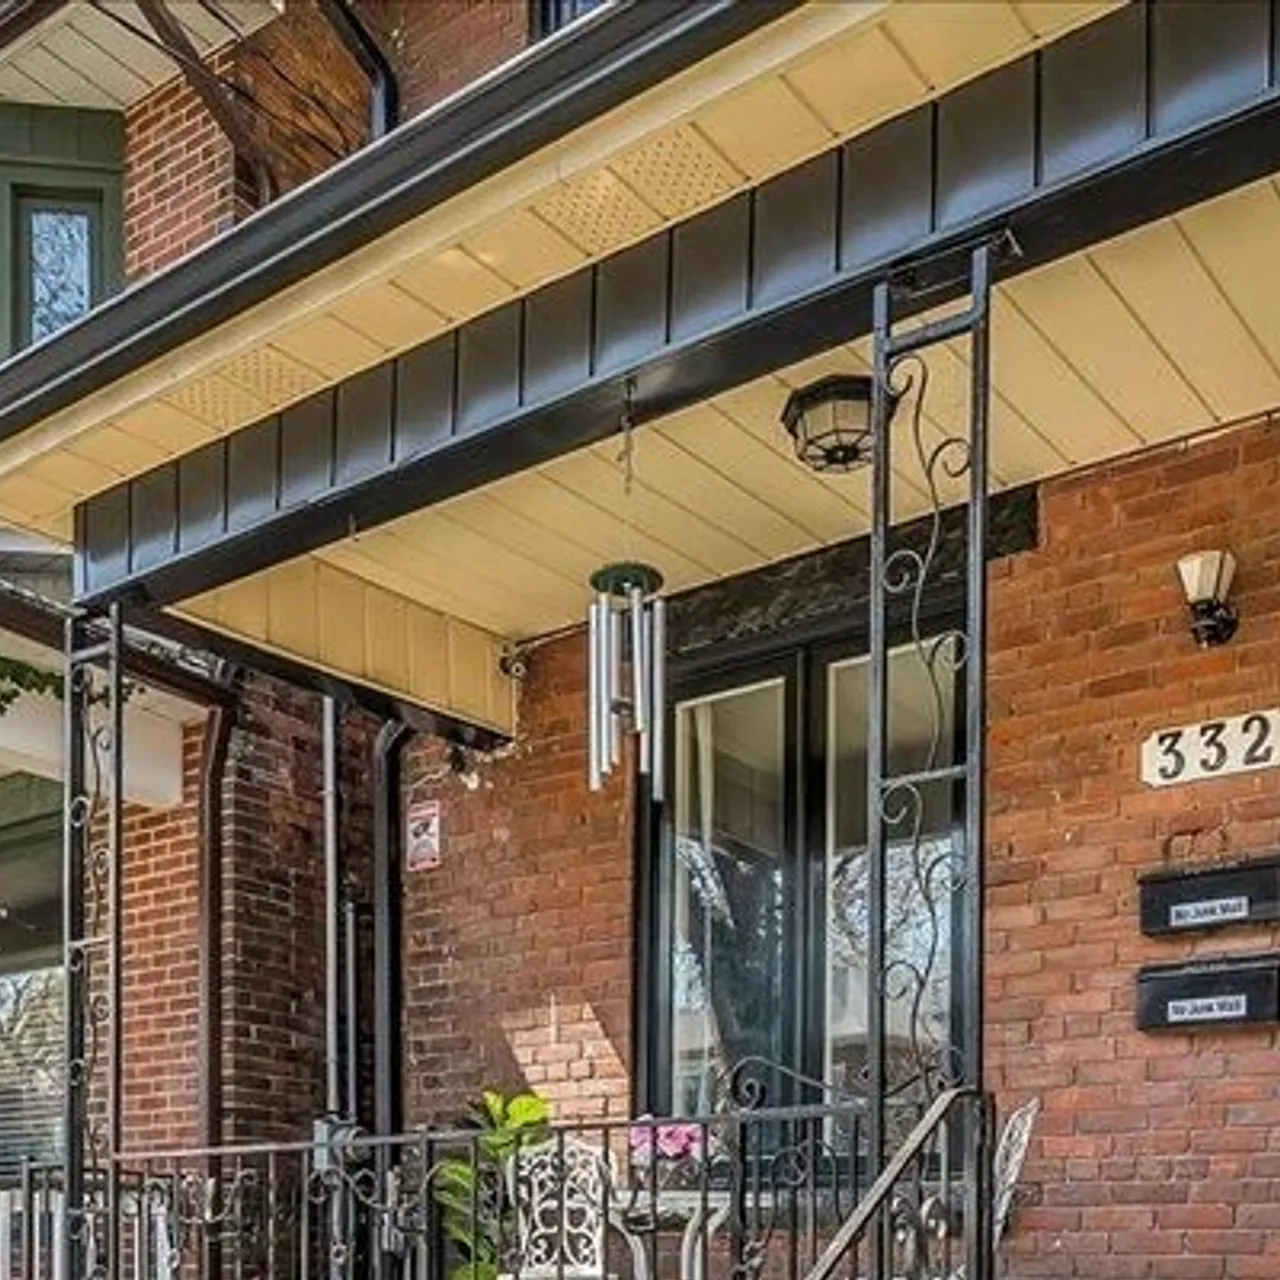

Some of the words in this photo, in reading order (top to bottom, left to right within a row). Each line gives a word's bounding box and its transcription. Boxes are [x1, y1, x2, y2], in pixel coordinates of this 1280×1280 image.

[1157, 713, 1273, 781] 332
[1174, 907, 1191, 920] No
[1191, 903, 1218, 919] Junk
[1219, 900, 1243, 915] Mail
[1187, 1001, 1214, 1016] Junk
[1216, 997, 1241, 1013] Mail
